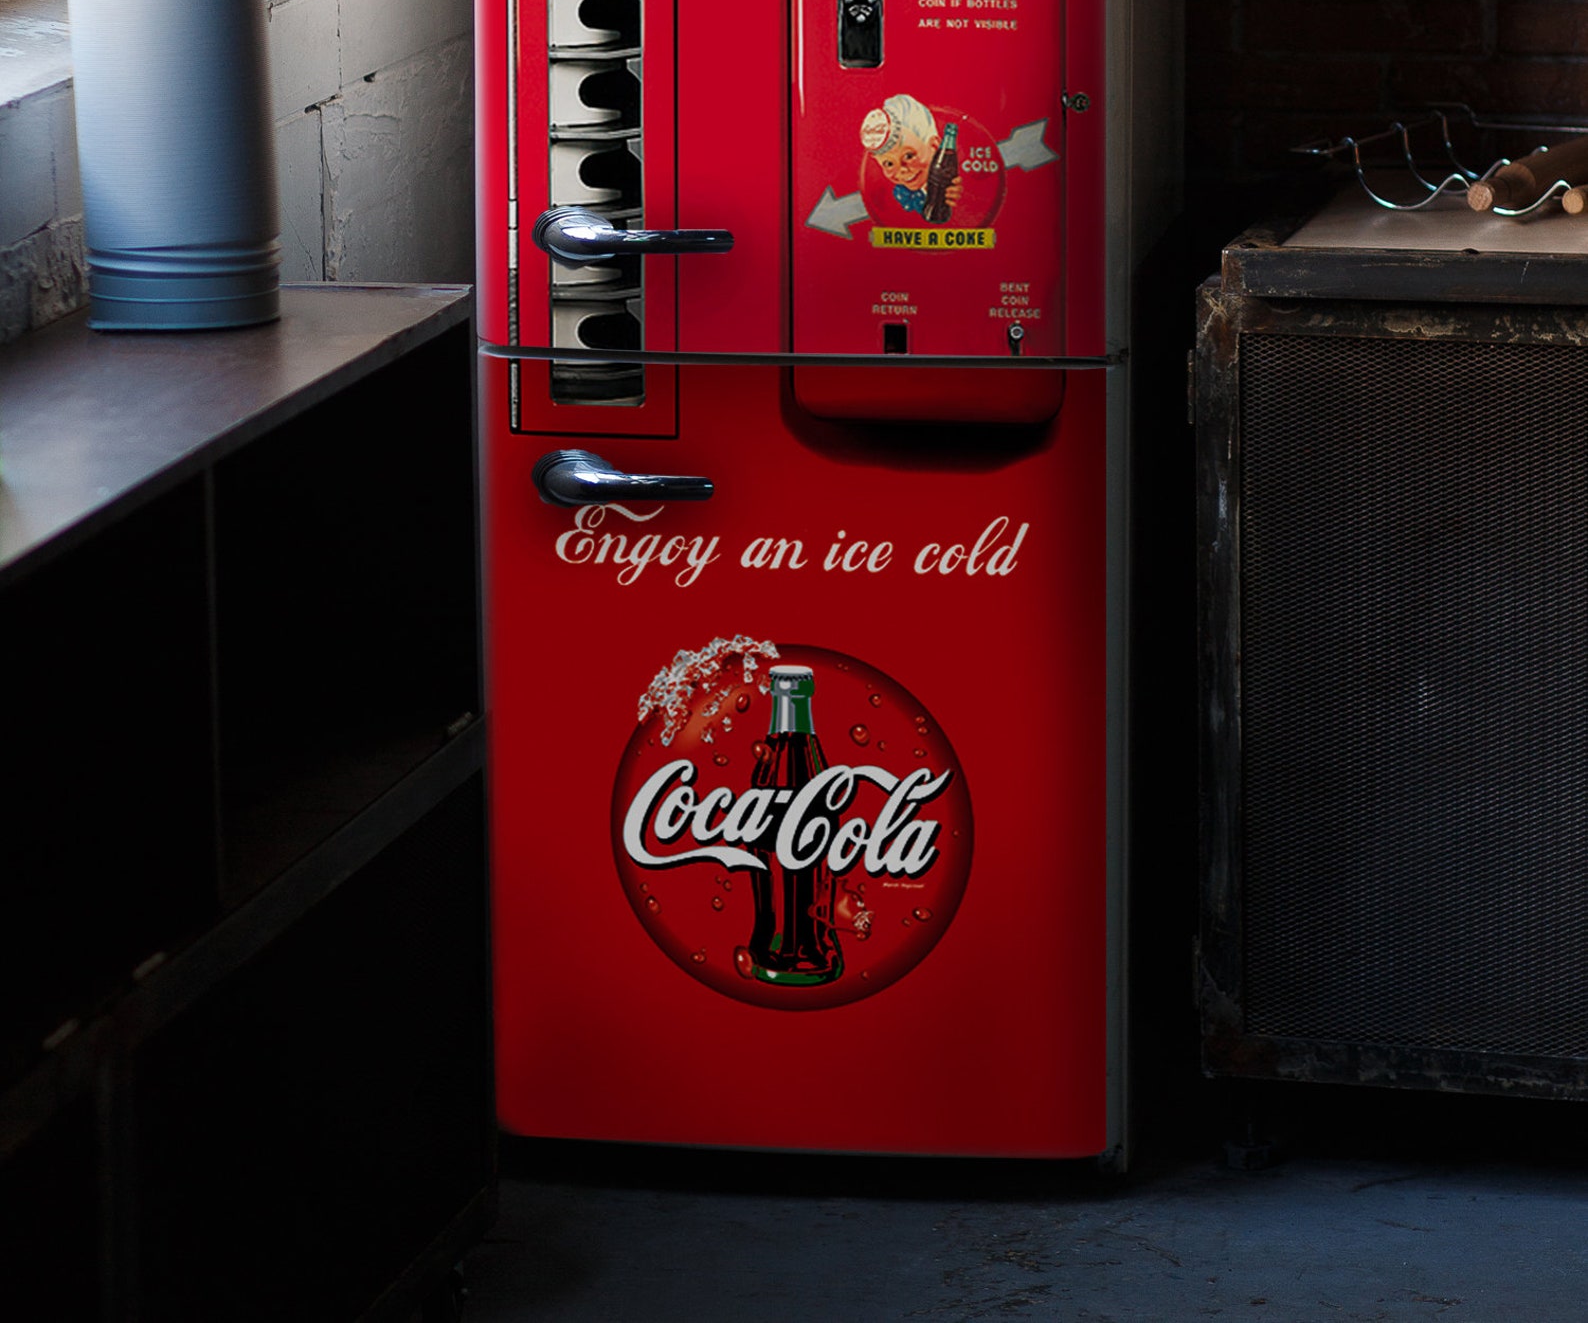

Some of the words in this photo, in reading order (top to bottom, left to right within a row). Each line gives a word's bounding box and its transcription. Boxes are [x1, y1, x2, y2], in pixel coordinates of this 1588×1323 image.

[918, 18, 940, 28] ARE
[946, 18, 969, 29] NOT
[974, 18, 1017, 30] VISIBLE
[970, 147, 991, 158] ICE
[962, 160, 998, 172] COLD
[883, 230, 922, 245] HAVE
[928, 230, 939, 245] A
[945, 231, 985, 246] COKE
[1000, 282, 1030, 293] BENT
[881, 291, 909, 302] COIN
[1001, 295, 1029, 306] COIN
[872, 304, 917, 315] RETURN
[989, 308, 1041, 319] RELEASE
[740, 536, 807, 570] an
[823, 530, 893, 573] ice
[914, 516, 1029, 576] cold
[623, 759, 950, 874] Coca-Cola
